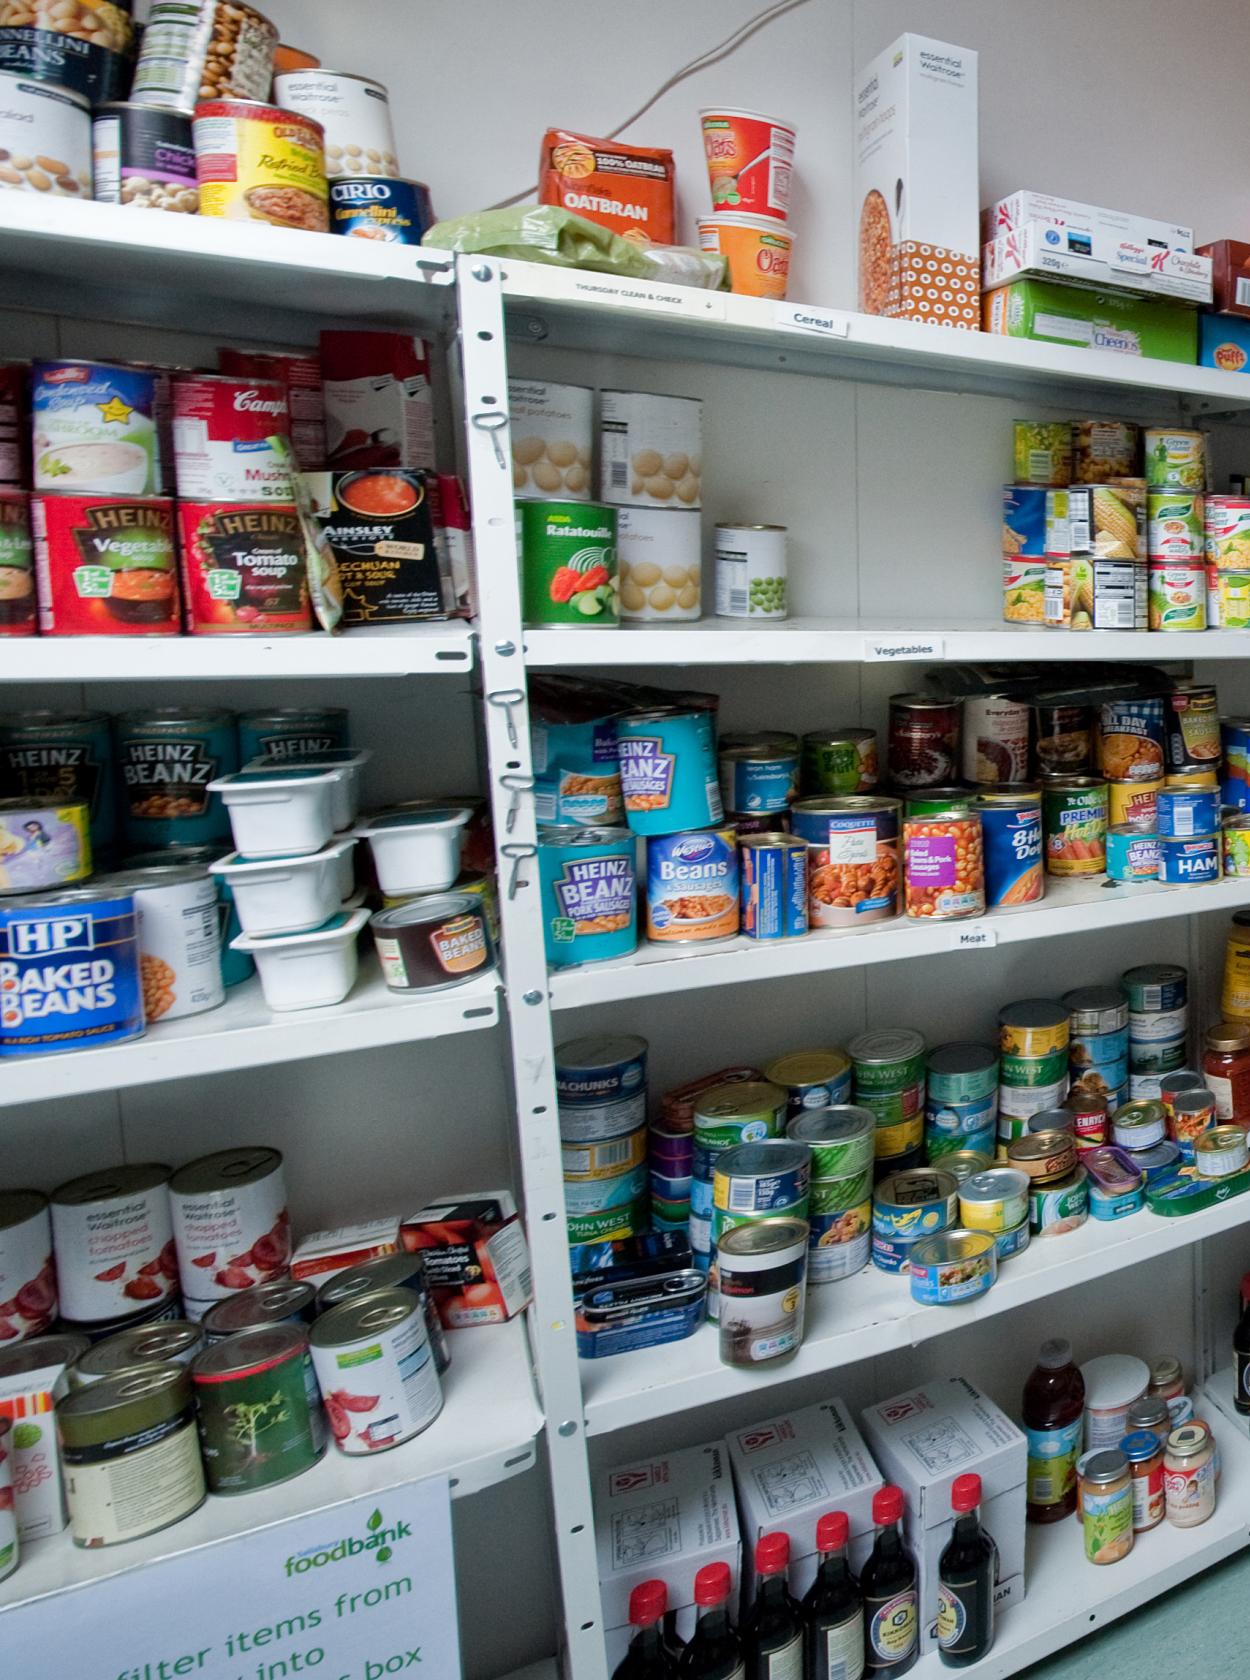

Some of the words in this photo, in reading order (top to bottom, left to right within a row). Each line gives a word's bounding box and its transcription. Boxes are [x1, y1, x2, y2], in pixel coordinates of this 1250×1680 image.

[0, 44, 66, 66] EANS
[257, 154, 309, 177] Refried
[331, 184, 392, 201] CIRIO
[564, 192, 649, 221] OATBRAN
[1116, 251, 1147, 266] Special
[1151, 250, 1171, 273] K
[575, 282, 619, 296] THURSDAY
[620, 288, 647, 299] CLEAN
[793, 311, 834, 330] Cereal
[95, 509, 169, 529] HEINZ
[223, 514, 298, 534] HEINZ
[323, 525, 394, 536] AINSLEY
[546, 525, 613, 540] Ratatouille
[232, 551, 298, 566] Tomato
[251, 566, 287, 579] soup
[875, 645, 934, 658] Vegetables
[985, 709, 1021, 717] Everyday
[1121, 716, 1148, 729] DAY
[10, 749, 81, 767] HEINZ
[131, 743, 195, 762] HEINZ
[125, 763, 211, 785] BEANZ
[829, 818, 876, 830] COQUETTE
[1054, 840, 1063, 849] 8
[573, 860, 627, 882] HEINZ
[660, 861, 728, 881] Beans
[1178, 856, 1218, 875] HAM
[561, 877, 634, 906] BEANZ
[567, 904, 591, 918] PORK
[16, 919, 83, 953] HP
[440, 928, 483, 952] BAKED
[960, 934, 987, 944] Meat
[0, 959, 115, 995] BAKED
[0, 982, 117, 1028] BEANS
[878, 1067, 908, 1079] WEST
[1016, 1065, 1043, 1075] WEST
[86, 1200, 147, 1222] essential
[182, 1197, 235, 1212] essential
[88, 1210, 151, 1231] Waitrose
[596, 1212, 631, 1229] WEST
[87, 1223, 149, 1246] chopped
[284, 1519, 412, 1578] foodbank
[224, 1608, 322, 1659] items
[334, 1575, 412, 1618] from
[256, 1646, 325, 1680] into
[364, 1645, 422, 1680] box
